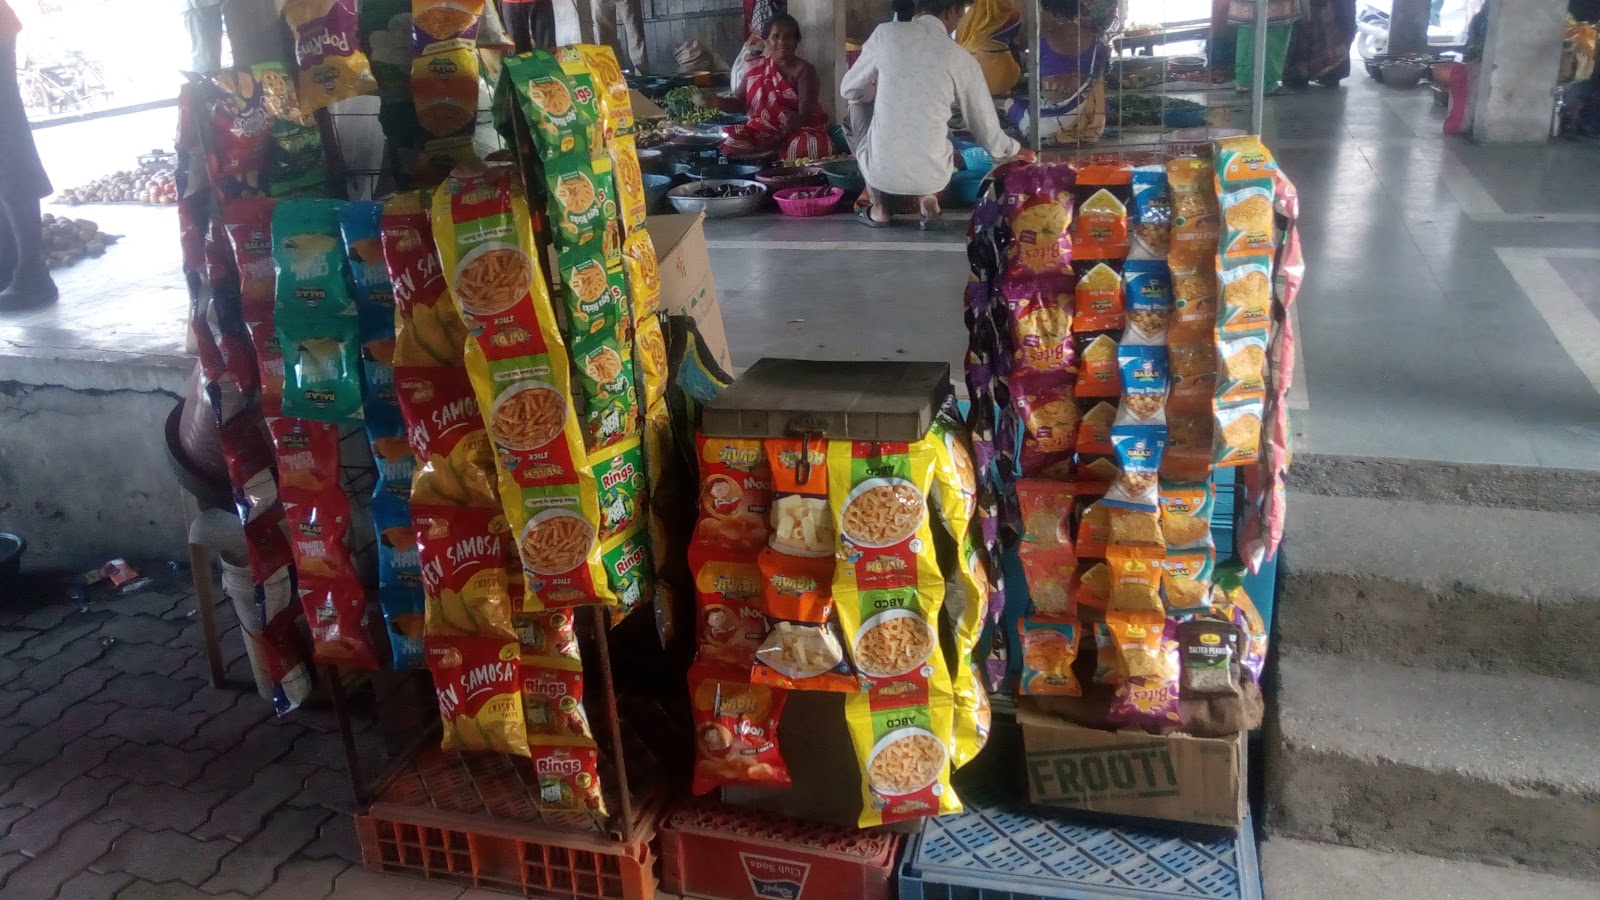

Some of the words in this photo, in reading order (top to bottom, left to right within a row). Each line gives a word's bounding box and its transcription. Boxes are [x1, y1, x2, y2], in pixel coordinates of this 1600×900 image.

[305, 390, 335, 400] BALAJI
[431, 395, 479, 430] SAMOS
[528, 451, 548, 461] STICK
[601, 462, 634, 490] Rings
[865, 465, 895, 475] ABCD
[446, 534, 501, 566] SAMOSA
[615, 545, 645, 577] Rings
[874, 598, 904, 608] ABCD
[460, 661, 514, 693] SAMOSA
[525, 678, 566, 698] Rings
[886, 715, 915, 728] ABCD
[537, 757, 582, 775] Rings
[1030, 751, 1177, 795] FROOTI
[750, 861, 776, 873] Soda
[778, 865, 801, 877] Club
